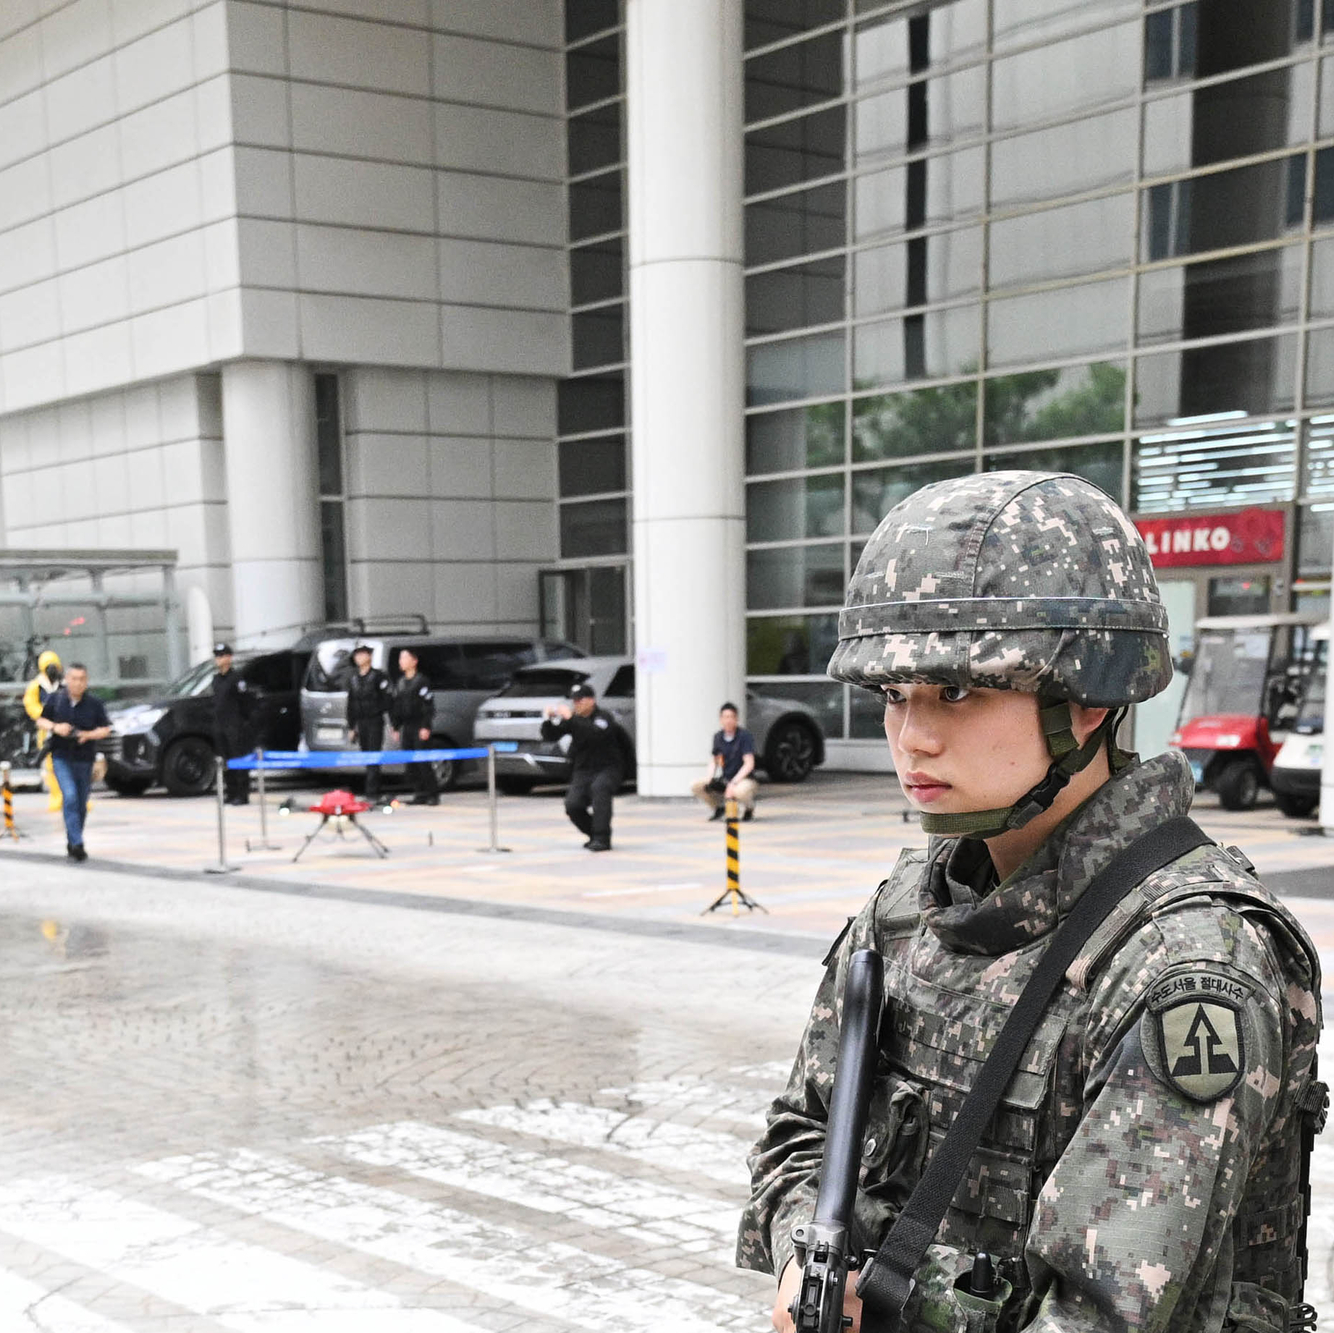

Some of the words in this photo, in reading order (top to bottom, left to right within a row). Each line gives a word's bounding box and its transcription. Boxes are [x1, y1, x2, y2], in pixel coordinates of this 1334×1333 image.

[1145, 526, 1231, 555] LINKO
[1151, 977, 1196, 1003] 수도서울
[1200, 976, 1244, 1000] 절대사수
